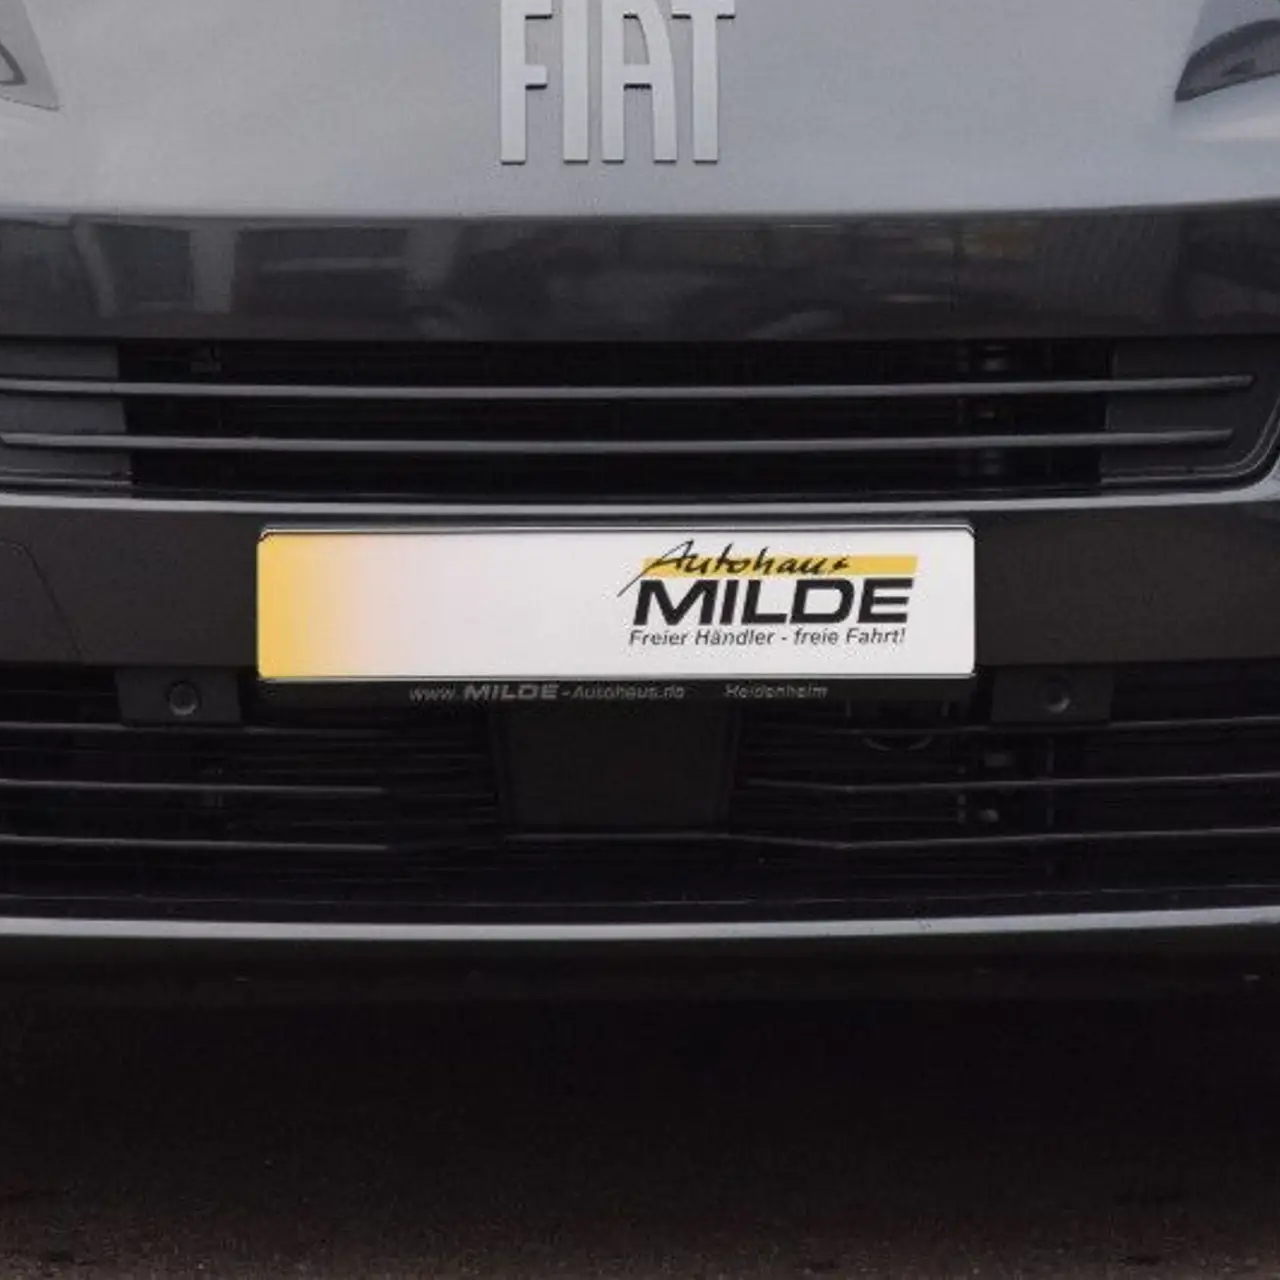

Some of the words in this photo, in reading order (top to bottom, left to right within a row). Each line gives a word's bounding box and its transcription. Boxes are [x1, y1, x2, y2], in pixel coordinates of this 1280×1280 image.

[617, 538, 851, 597] Autohaus
[633, 578, 915, 625] MILDE
[628, 629, 688, 646] Freier
[694, 628, 776, 646] Händler
[793, 627, 839, 646] freie
[845, 627, 907, 645] Fahrt!
